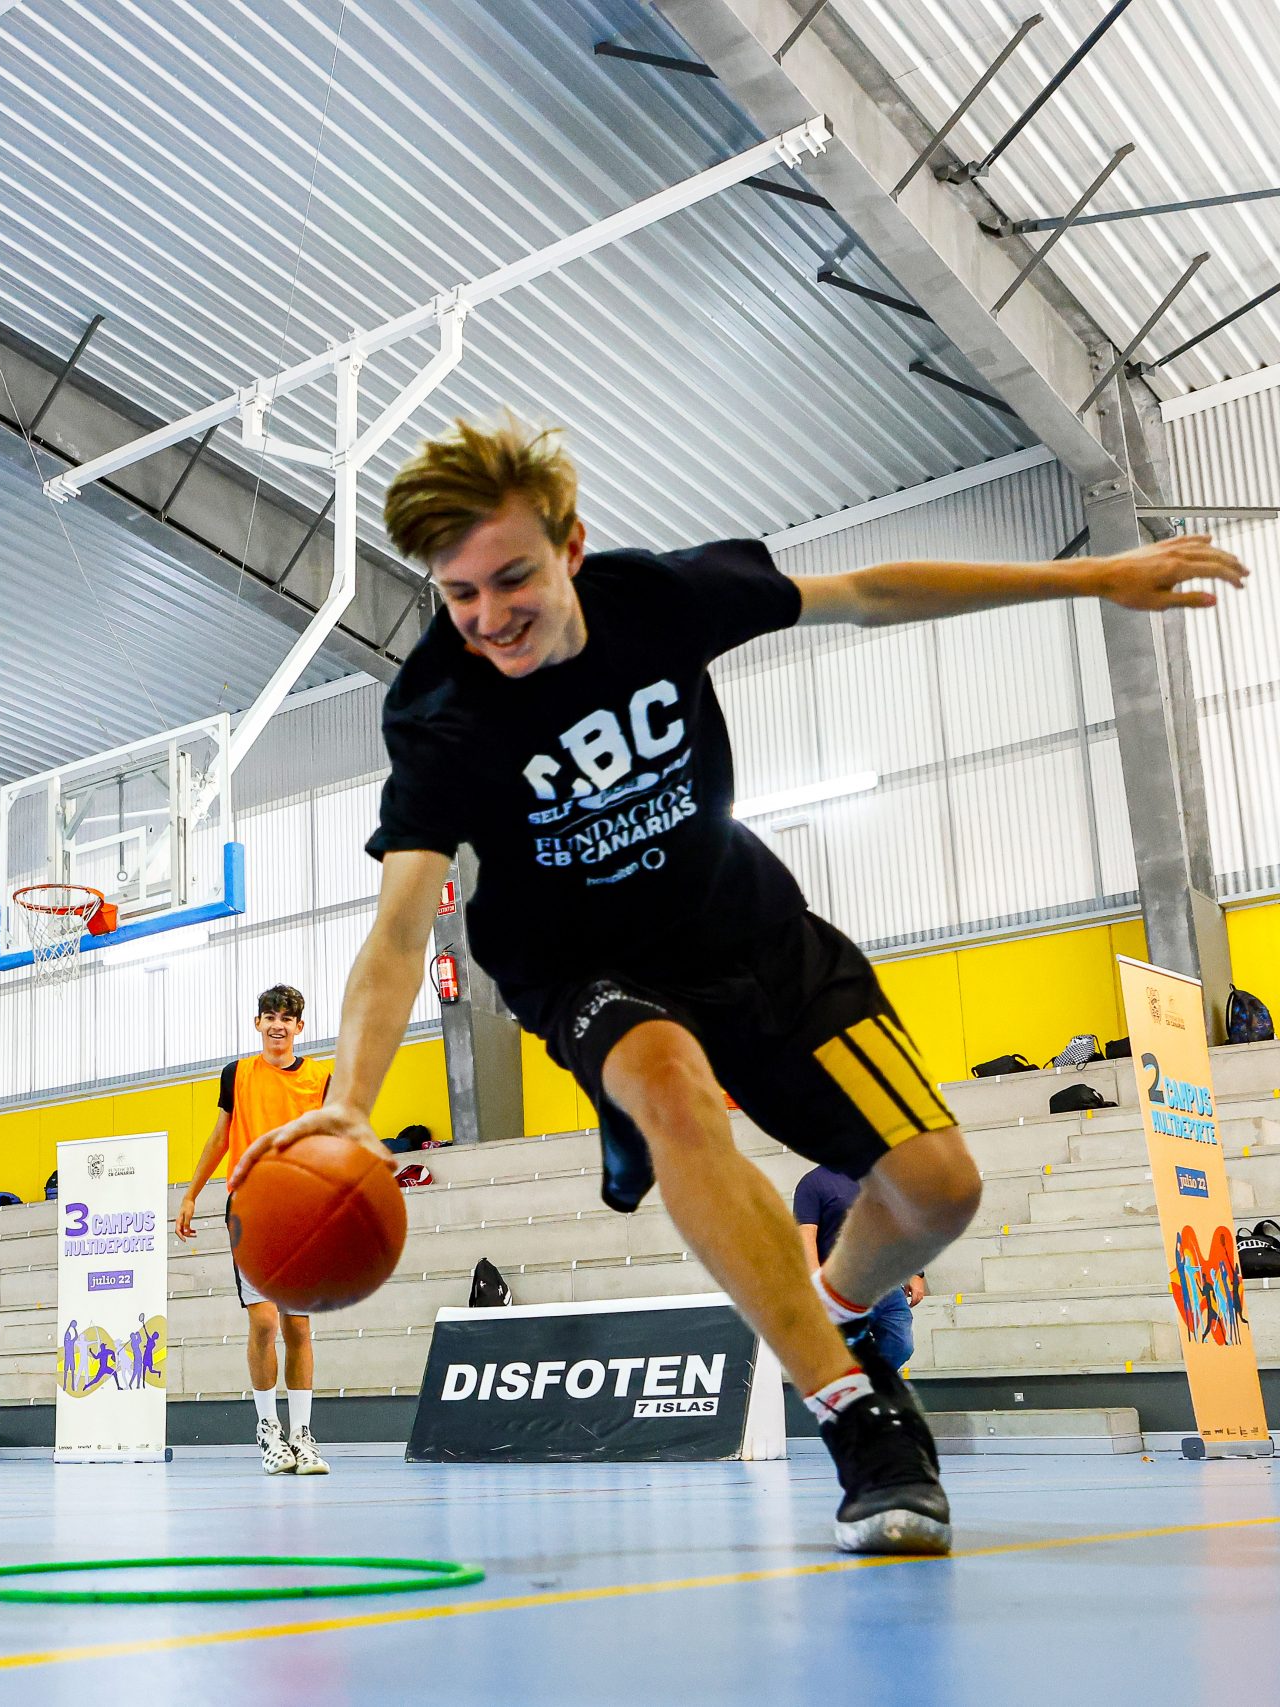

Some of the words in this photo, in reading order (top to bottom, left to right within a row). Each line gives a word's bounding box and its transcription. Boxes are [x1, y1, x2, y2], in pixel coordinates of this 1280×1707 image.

[522, 679, 685, 800] CBC
[528, 800, 573, 825] SELF
[536, 851, 572, 866] CB
[580, 795, 698, 864] CANARIAS
[1141, 1053, 1164, 1103] 2
[1164, 1077, 1213, 1117] CAMPUS
[1179, 1173, 1197, 1189] julio
[65, 1203, 89, 1237] 3
[92, 1211, 156, 1236] CAMPUS
[64, 1235, 154, 1257] MULTIDEPORTE
[90, 1275, 116, 1288] julio
[118, 1274, 131, 1285] 22
[441, 1353, 726, 1401] DISFOTEN
[638, 1403, 649, 1414] 7
[655, 1401, 715, 1413] ISLAS
